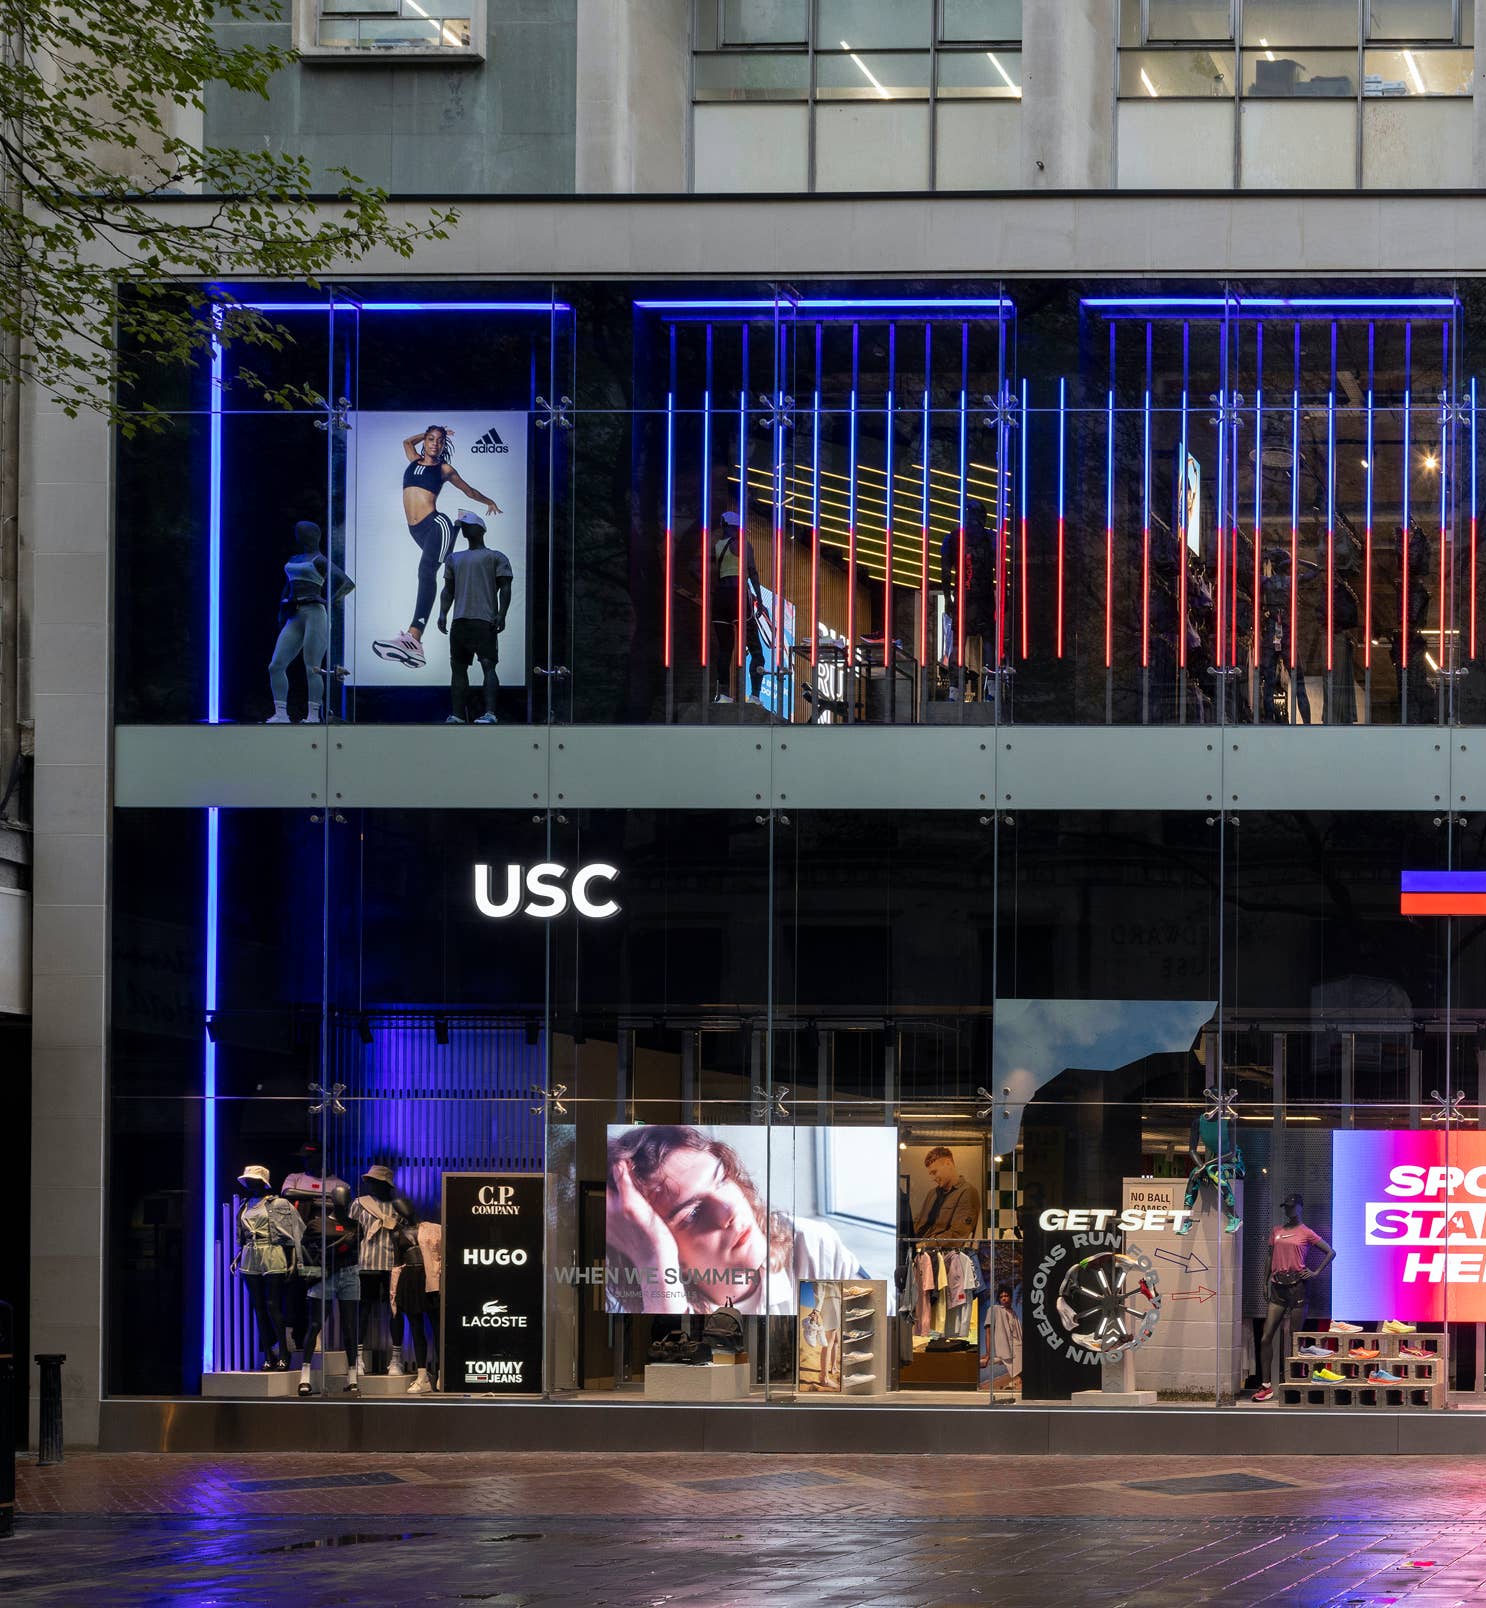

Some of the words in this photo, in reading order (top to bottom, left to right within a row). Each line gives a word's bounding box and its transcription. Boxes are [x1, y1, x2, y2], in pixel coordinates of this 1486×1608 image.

[471, 444, 509, 453] adidas
[474, 863, 620, 918] USC
[478, 1185, 515, 1205] C.P.
[1131, 1192, 1144, 1202] NO
[1148, 1193, 1171, 1203] BALL
[471, 1205, 520, 1215] COMPANY
[1039, 1209, 1116, 1231] GET
[1118, 1209, 1192, 1231] SET
[1072, 1232, 1122, 1249] RUN
[463, 1248, 527, 1265] HUGO
[554, 1266, 619, 1285] WHEN
[624, 1267, 659, 1285] WE
[664, 1267, 759, 1286] SUMMER
[615, 1290, 649, 1298] SUMMER
[651, 1291, 697, 1299] ESSENTIALS
[1031, 1243, 1067, 1351] REASONS
[462, 1316, 527, 1327] LACOSTE
[1065, 1346, 1123, 1366] OWN
[465, 1361, 523, 1373] TOMMY
[488, 1374, 523, 1383] JEANS
